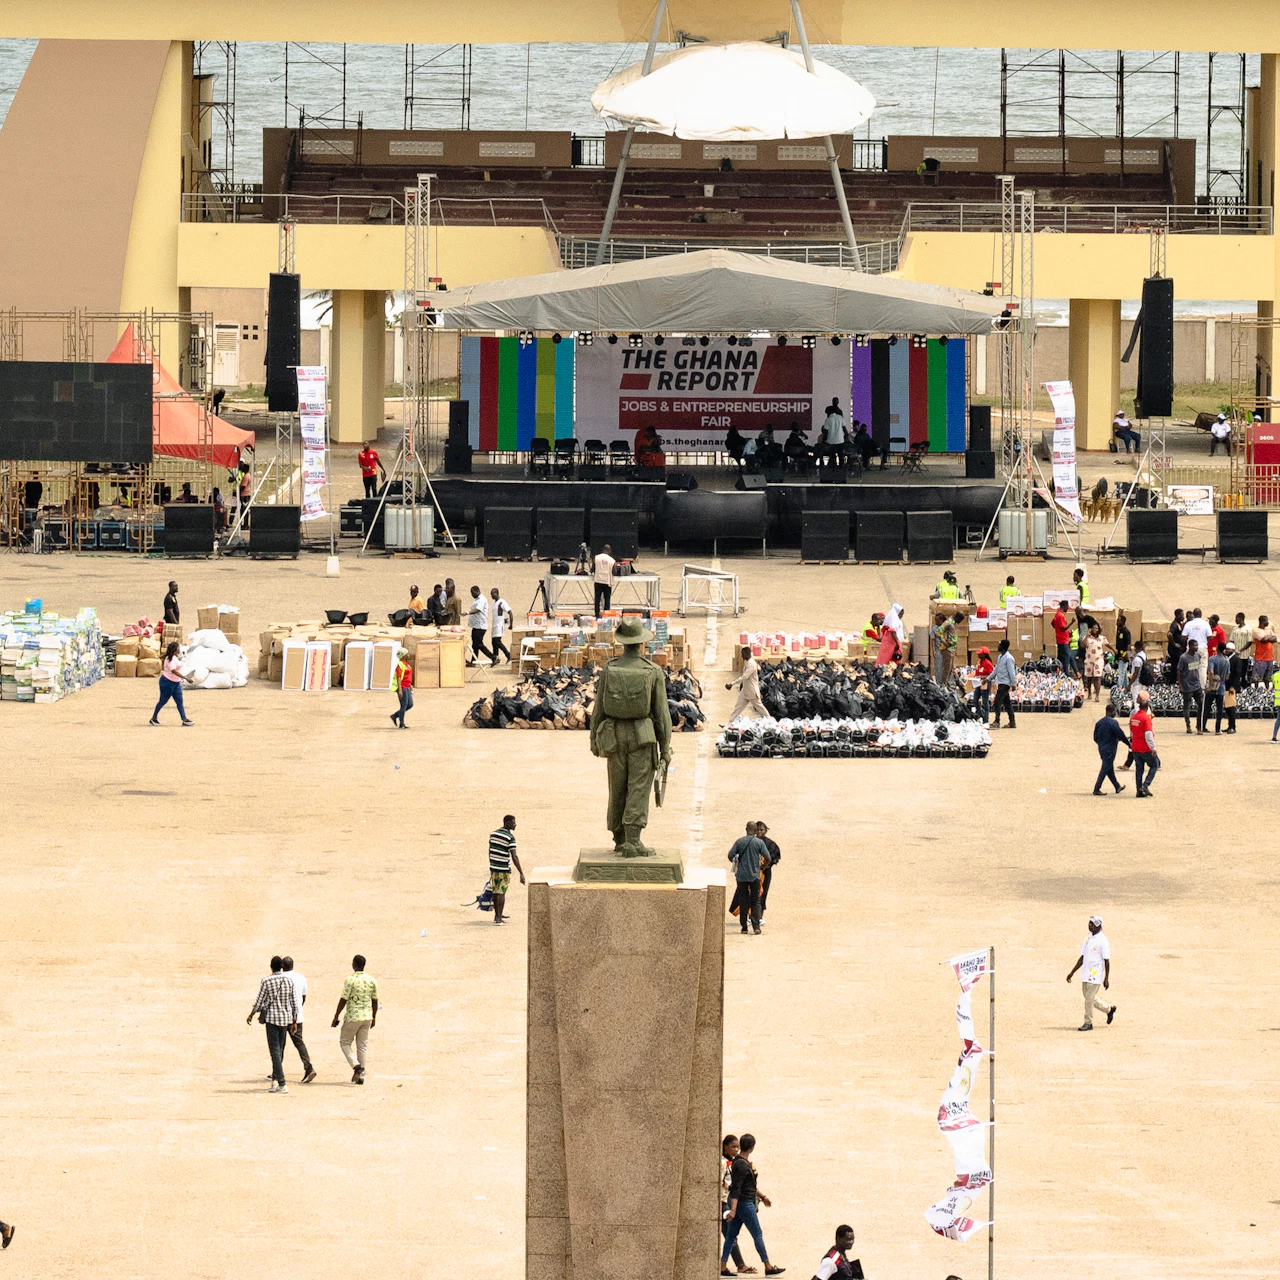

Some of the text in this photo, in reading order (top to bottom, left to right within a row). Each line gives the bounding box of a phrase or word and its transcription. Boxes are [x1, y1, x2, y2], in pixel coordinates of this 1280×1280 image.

[621, 350, 757, 370] THE GHANA
[656, 371, 755, 391] REPORT
[622, 400, 810, 413] JOBS & ENTREPRENEURSHIP
[701, 416, 731, 427] FAIR
